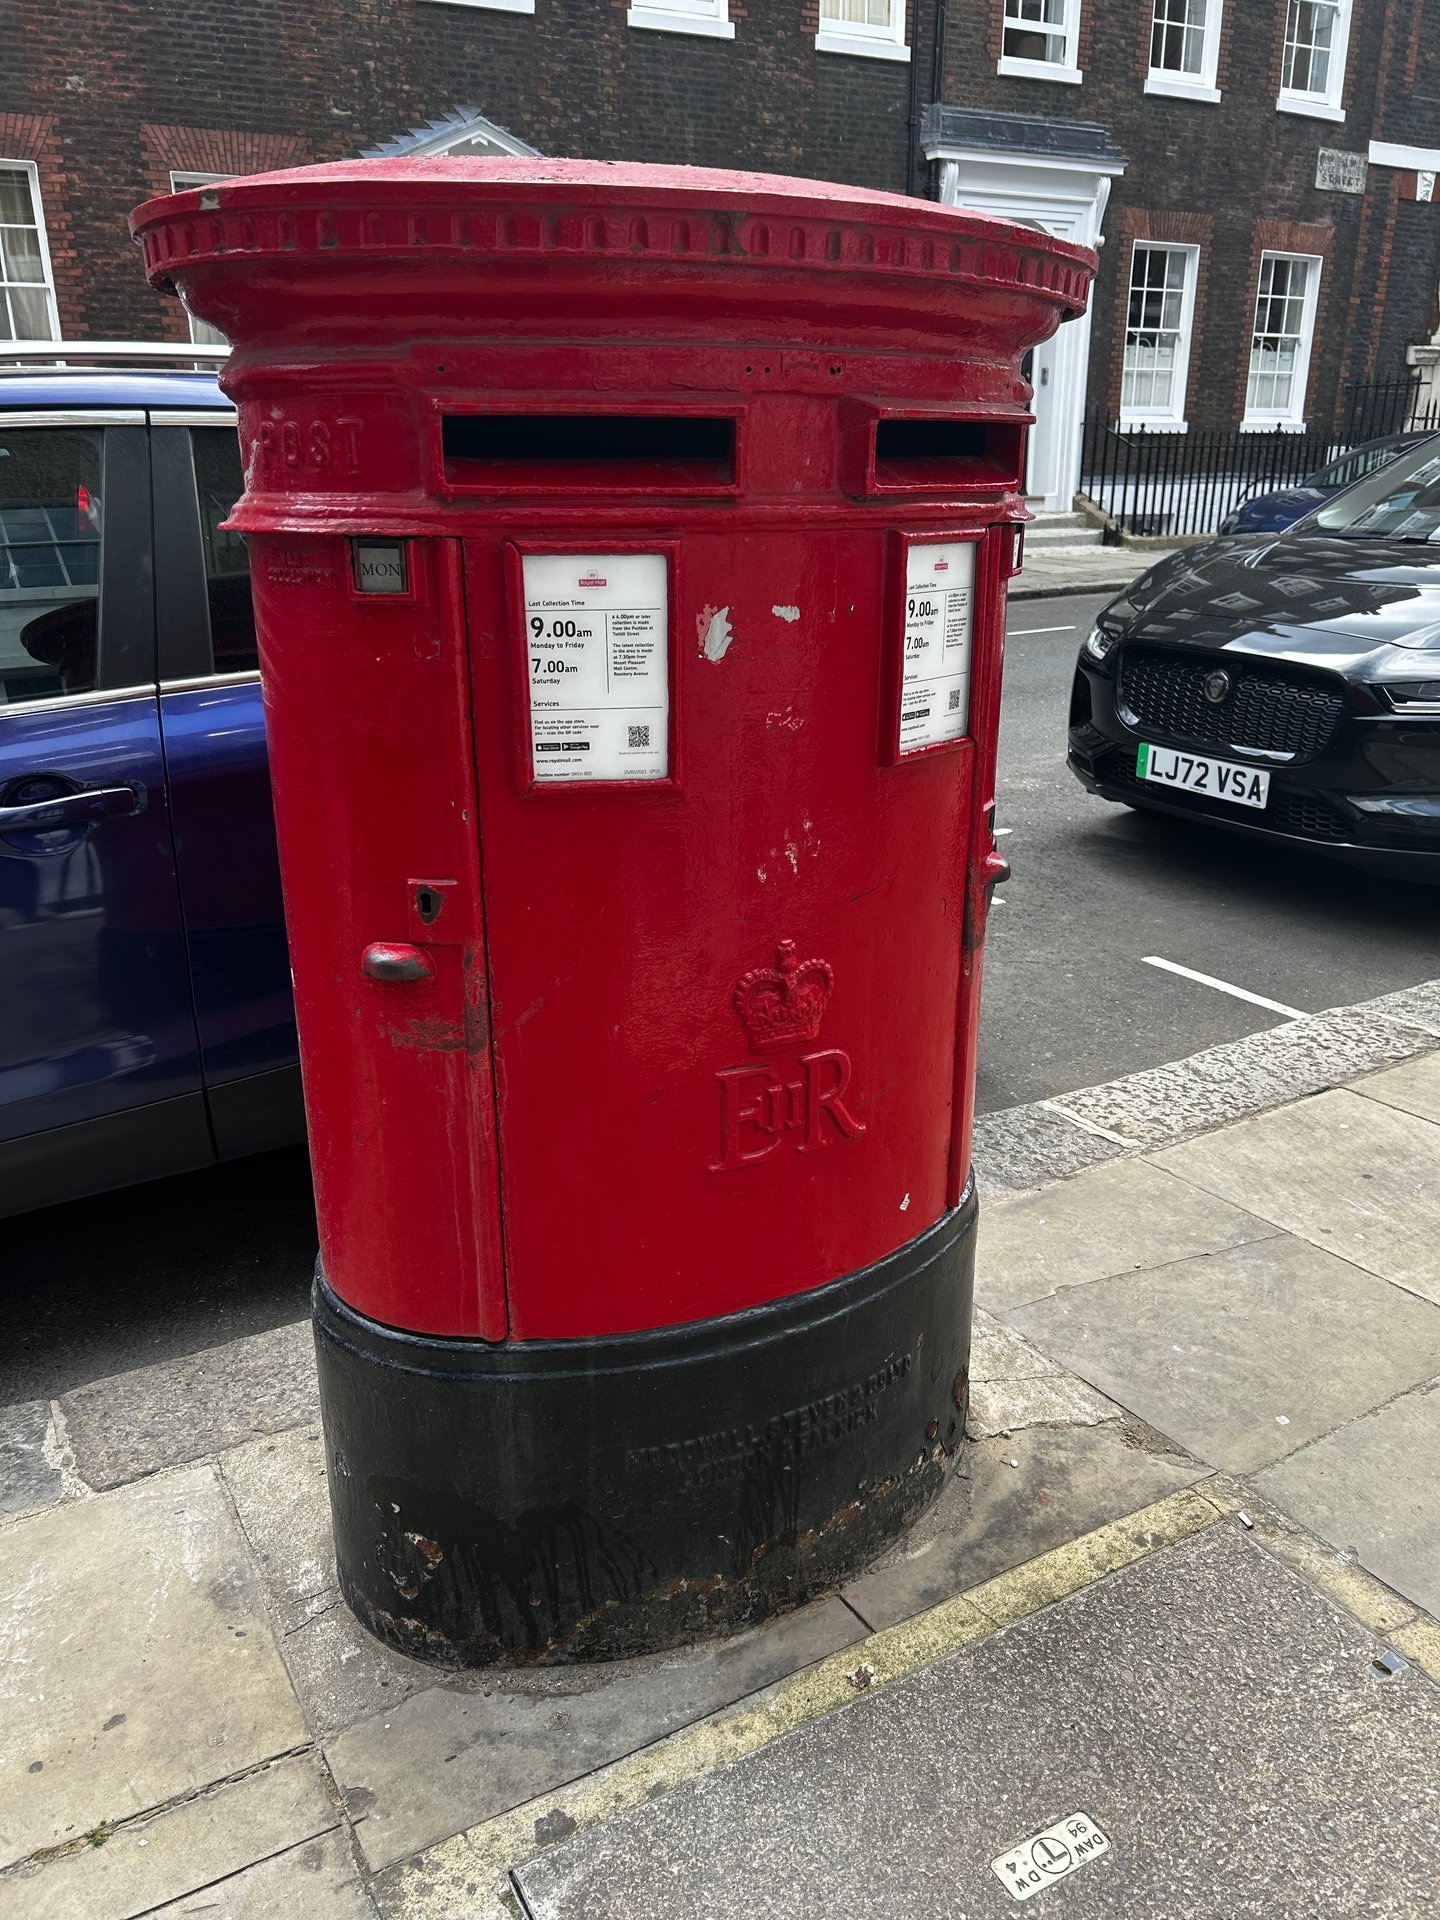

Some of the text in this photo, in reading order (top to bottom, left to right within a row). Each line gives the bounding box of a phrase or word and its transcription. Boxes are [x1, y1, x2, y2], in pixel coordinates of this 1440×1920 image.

[260, 418, 364, 475] POST
[362, 563, 400, 576] MON
[909, 599, 938, 618] 9.00am
[530, 617, 592, 638] 9.00am
[906, 637, 929, 650] 7.00am
[532, 659, 578, 673] 7.00am
[1150, 750, 1261, 802] LJ72 VSA
[1068, 1822, 1087, 1838] 94
[1074, 1833, 1104, 1857] DAW
[1005, 1862, 1017, 1874] 4
